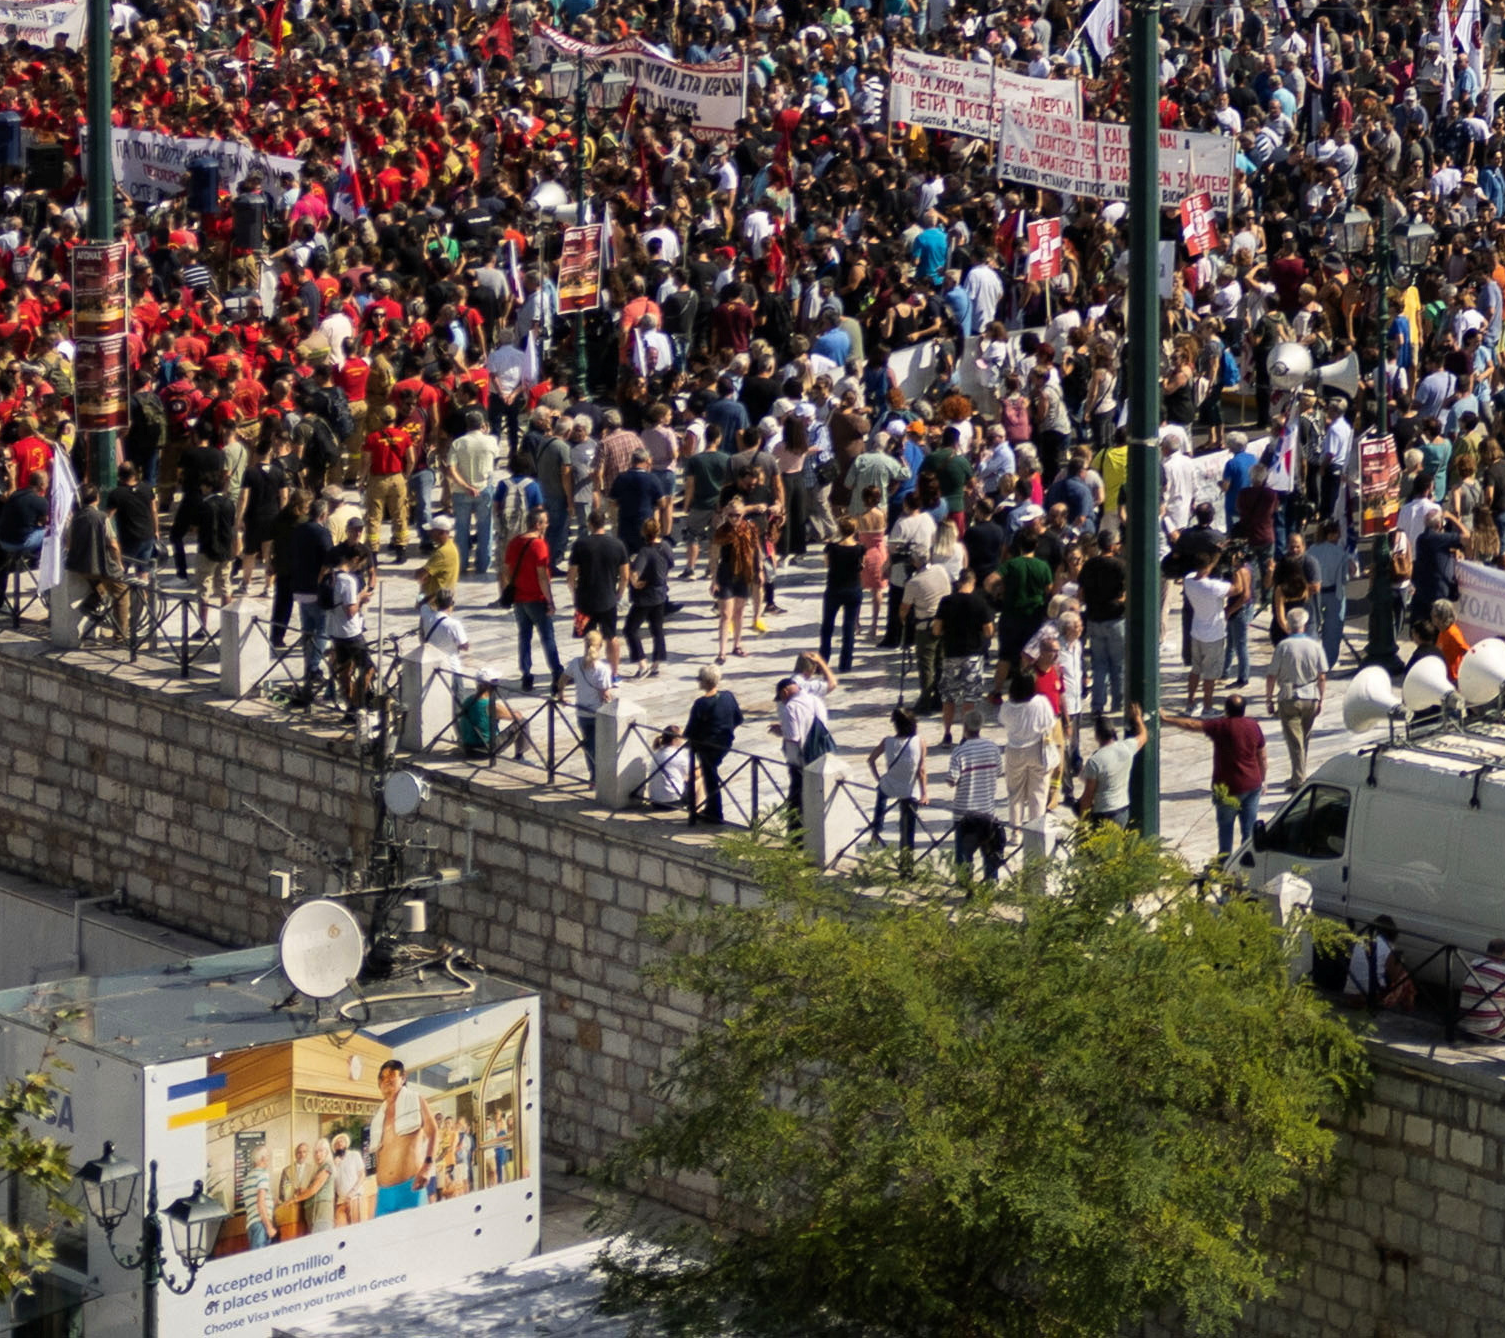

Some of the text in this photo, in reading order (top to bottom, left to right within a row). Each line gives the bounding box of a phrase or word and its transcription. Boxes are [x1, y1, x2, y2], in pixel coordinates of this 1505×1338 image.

[910, 90, 1074, 124] ΜΕΤΡΑ ΠΡΟΣΤΑΣ ΑΠΕΡΓΙΑ
[203, 1265, 347, 1317] of places worldwide
[204, 1265, 273, 1299] Accepted
[275, 1260, 289, 1271] in
[203, 1273, 408, 1336] Choose Visa when you travel in Greece
